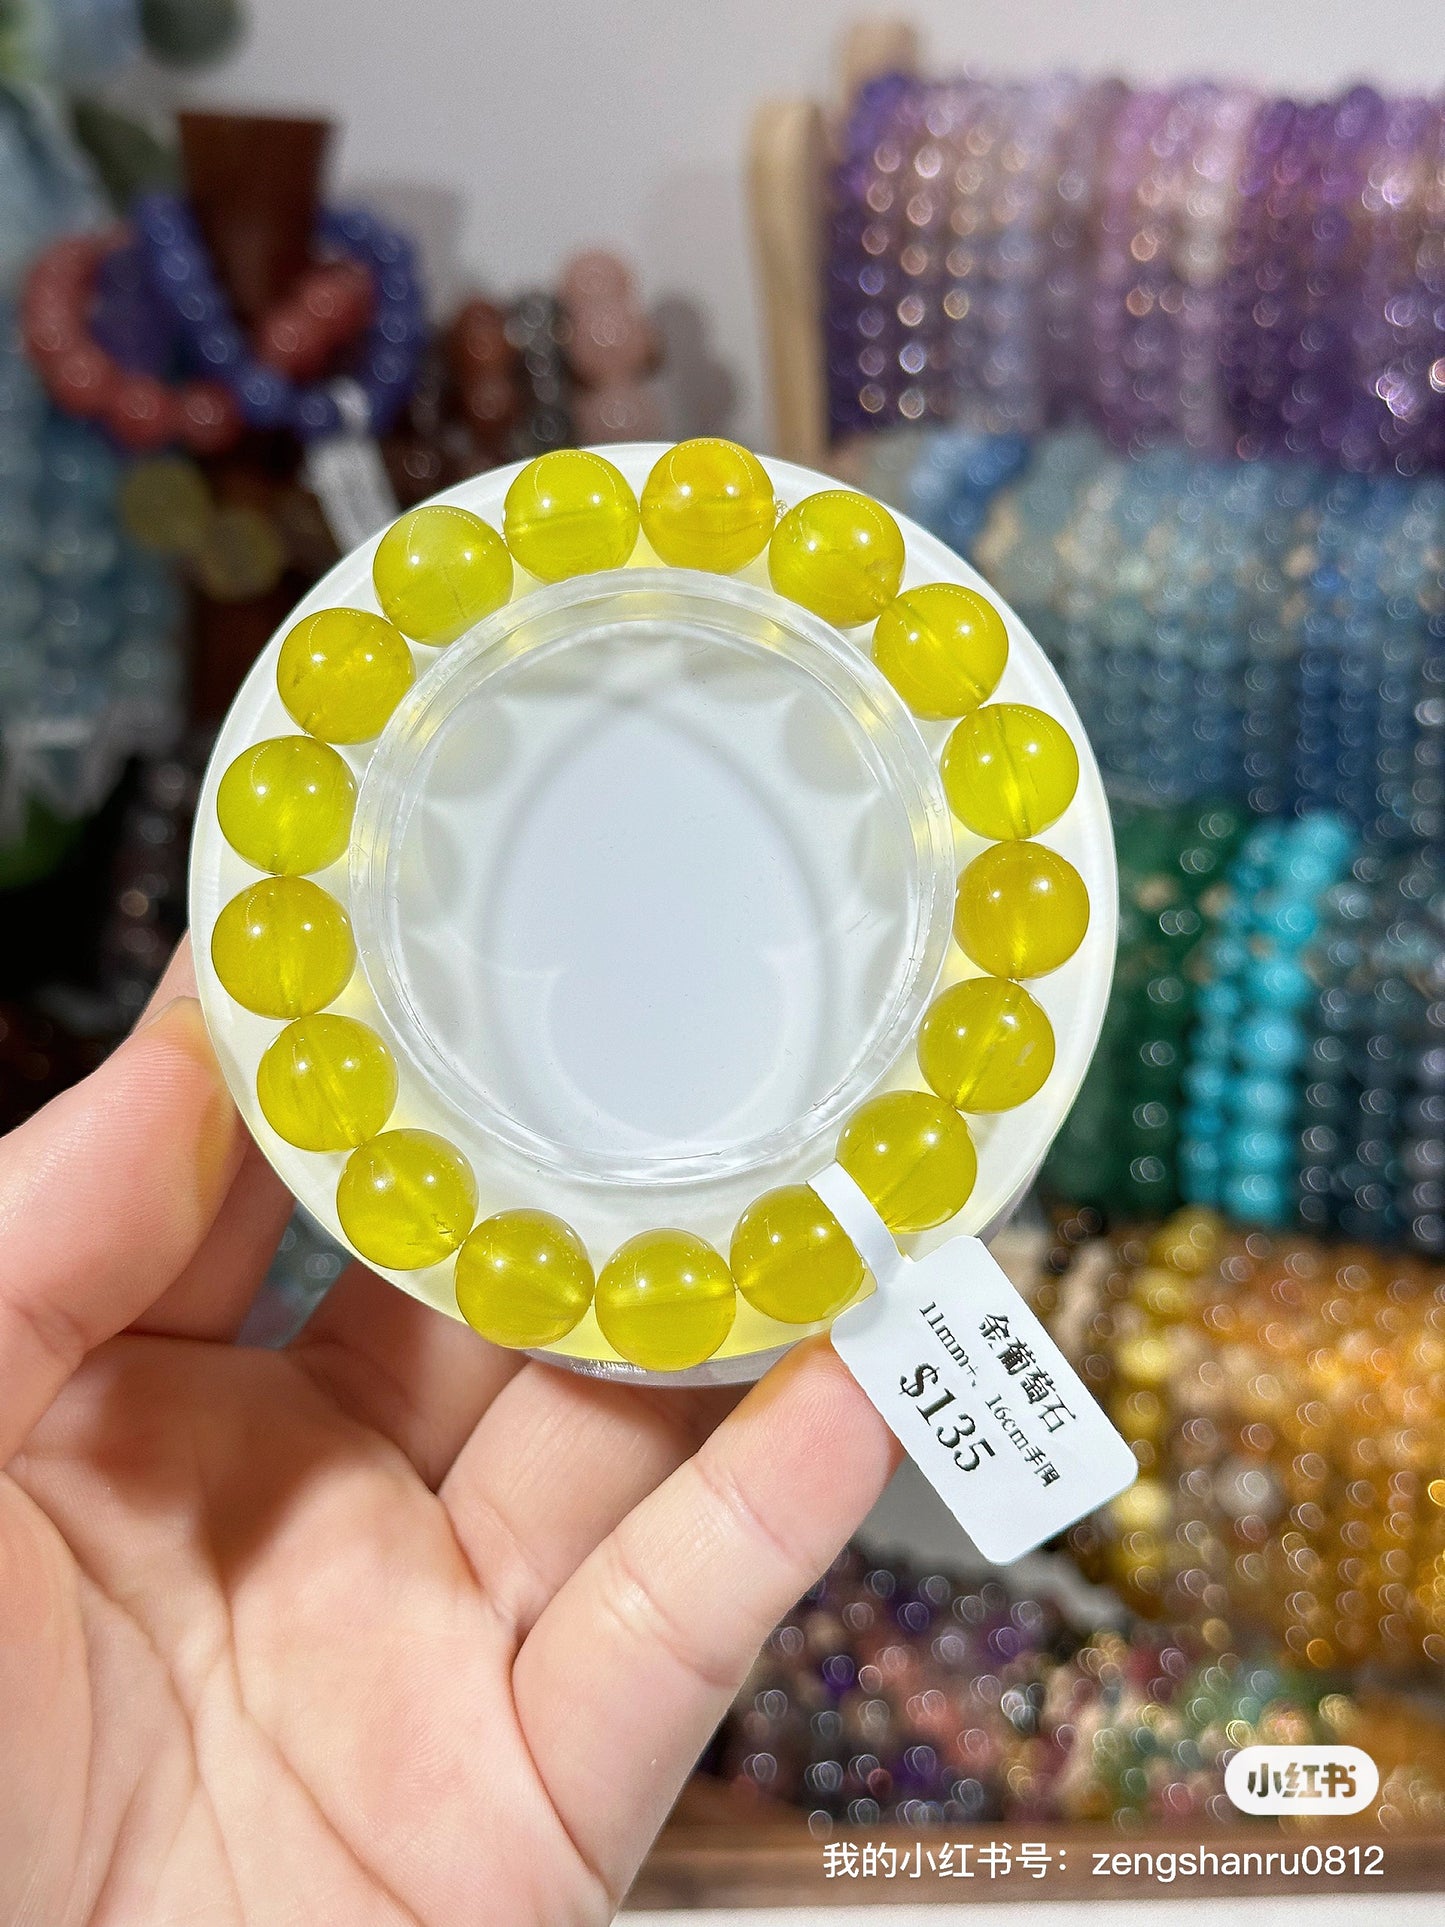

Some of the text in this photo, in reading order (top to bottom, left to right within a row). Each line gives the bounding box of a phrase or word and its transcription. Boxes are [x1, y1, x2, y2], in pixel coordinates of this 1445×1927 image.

[899, 1362, 996, 1472] $135
[979, 1313, 1076, 1433] 金葡萄石
